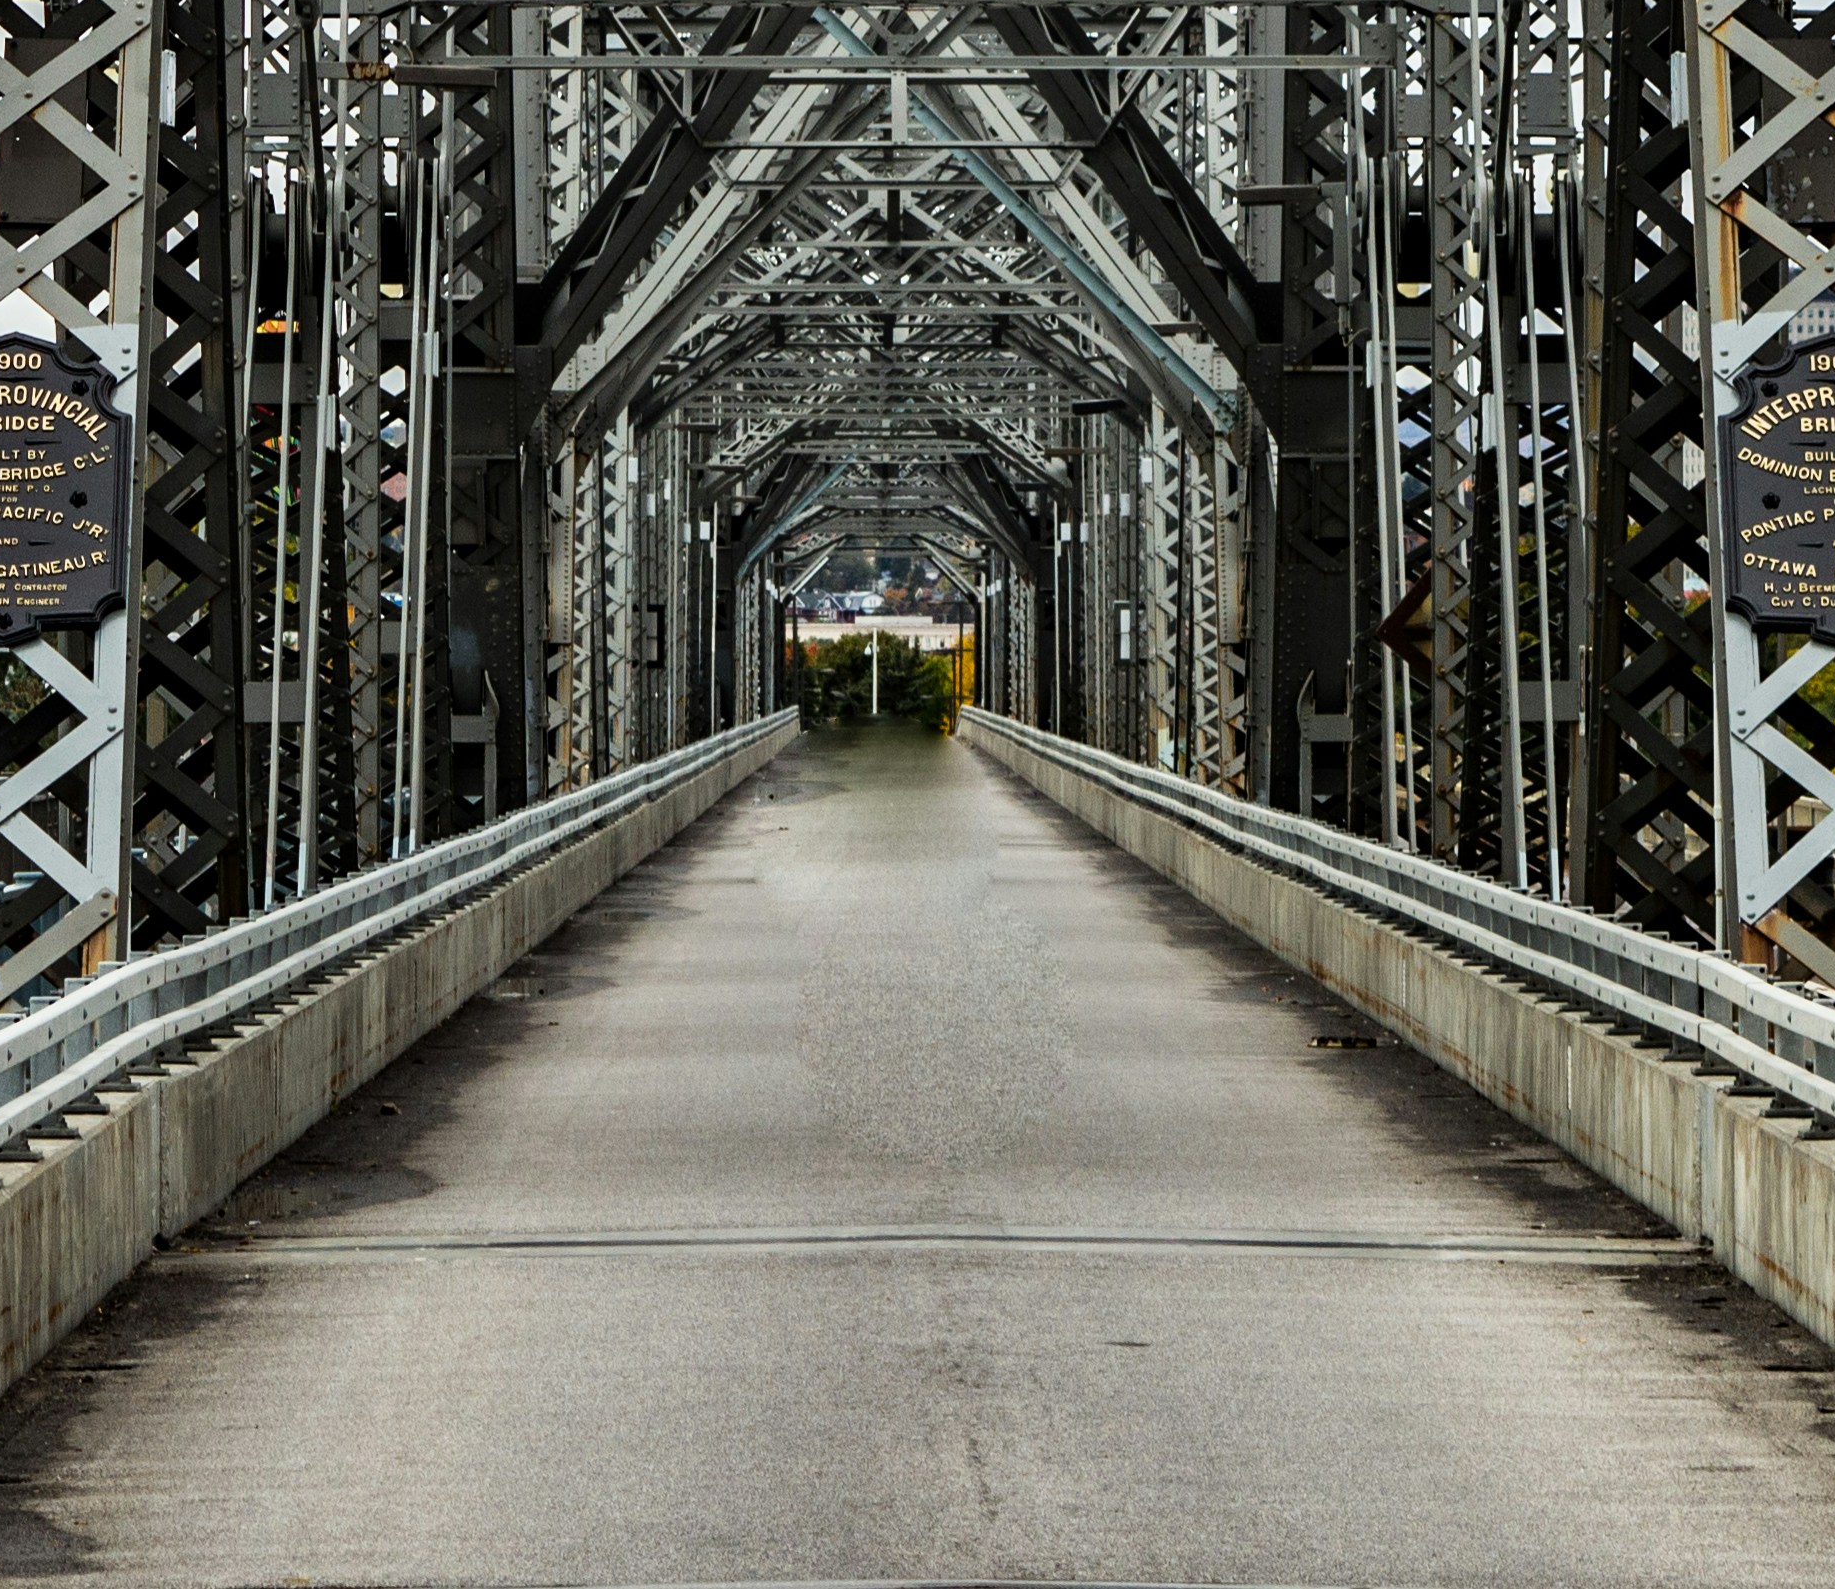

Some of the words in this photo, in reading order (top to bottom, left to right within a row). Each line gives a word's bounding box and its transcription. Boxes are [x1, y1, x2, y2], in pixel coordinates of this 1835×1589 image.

[28, 450, 46, 460] BY
[1737, 447, 1822, 481] DOMINION
[0, 463, 66, 480] BRIDGE
[1740, 510, 1815, 543] PONTIAC
[1743, 553, 1817, 577] OTTAWA
